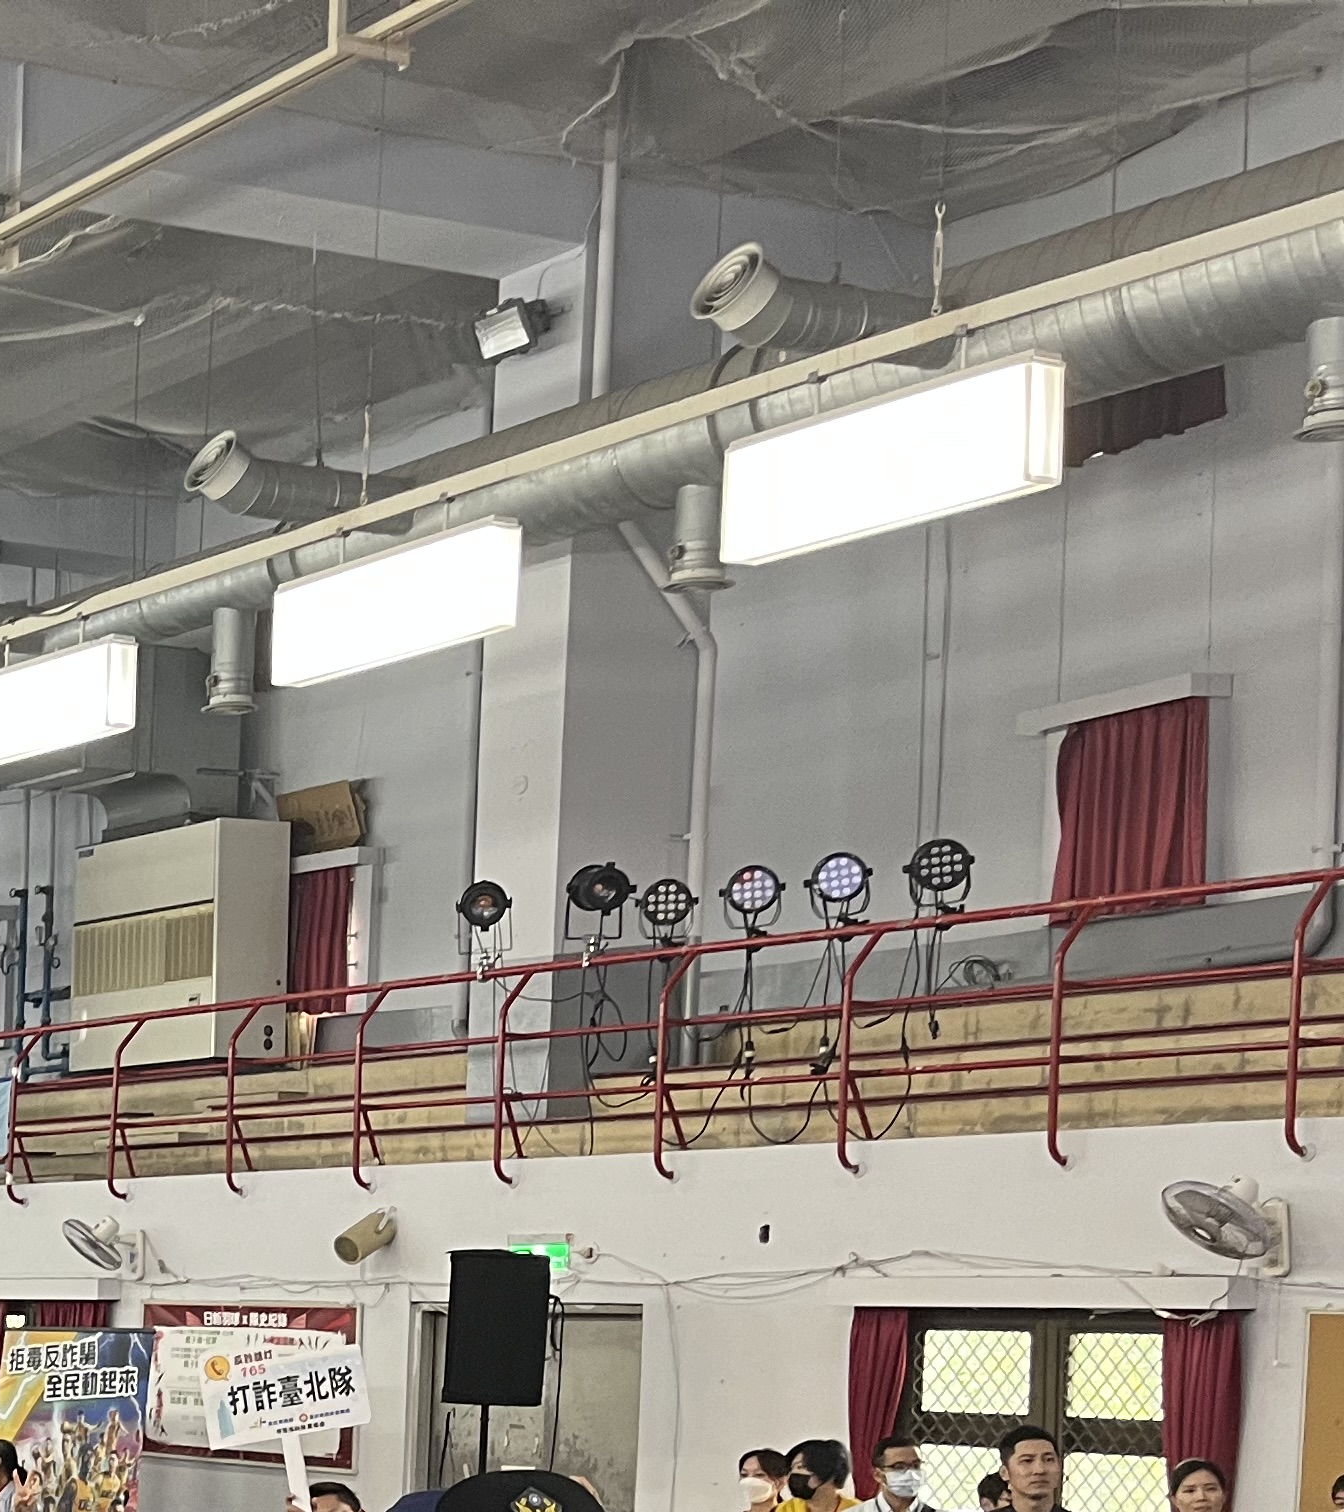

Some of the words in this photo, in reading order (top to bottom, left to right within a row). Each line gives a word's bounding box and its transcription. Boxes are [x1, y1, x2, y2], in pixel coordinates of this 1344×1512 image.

[9, 1340, 97, 1371] 拒毒反詐騙
[46, 1368, 137, 1398] 全民動起來
[228, 1365, 356, 1415] 打詐臺北隊
